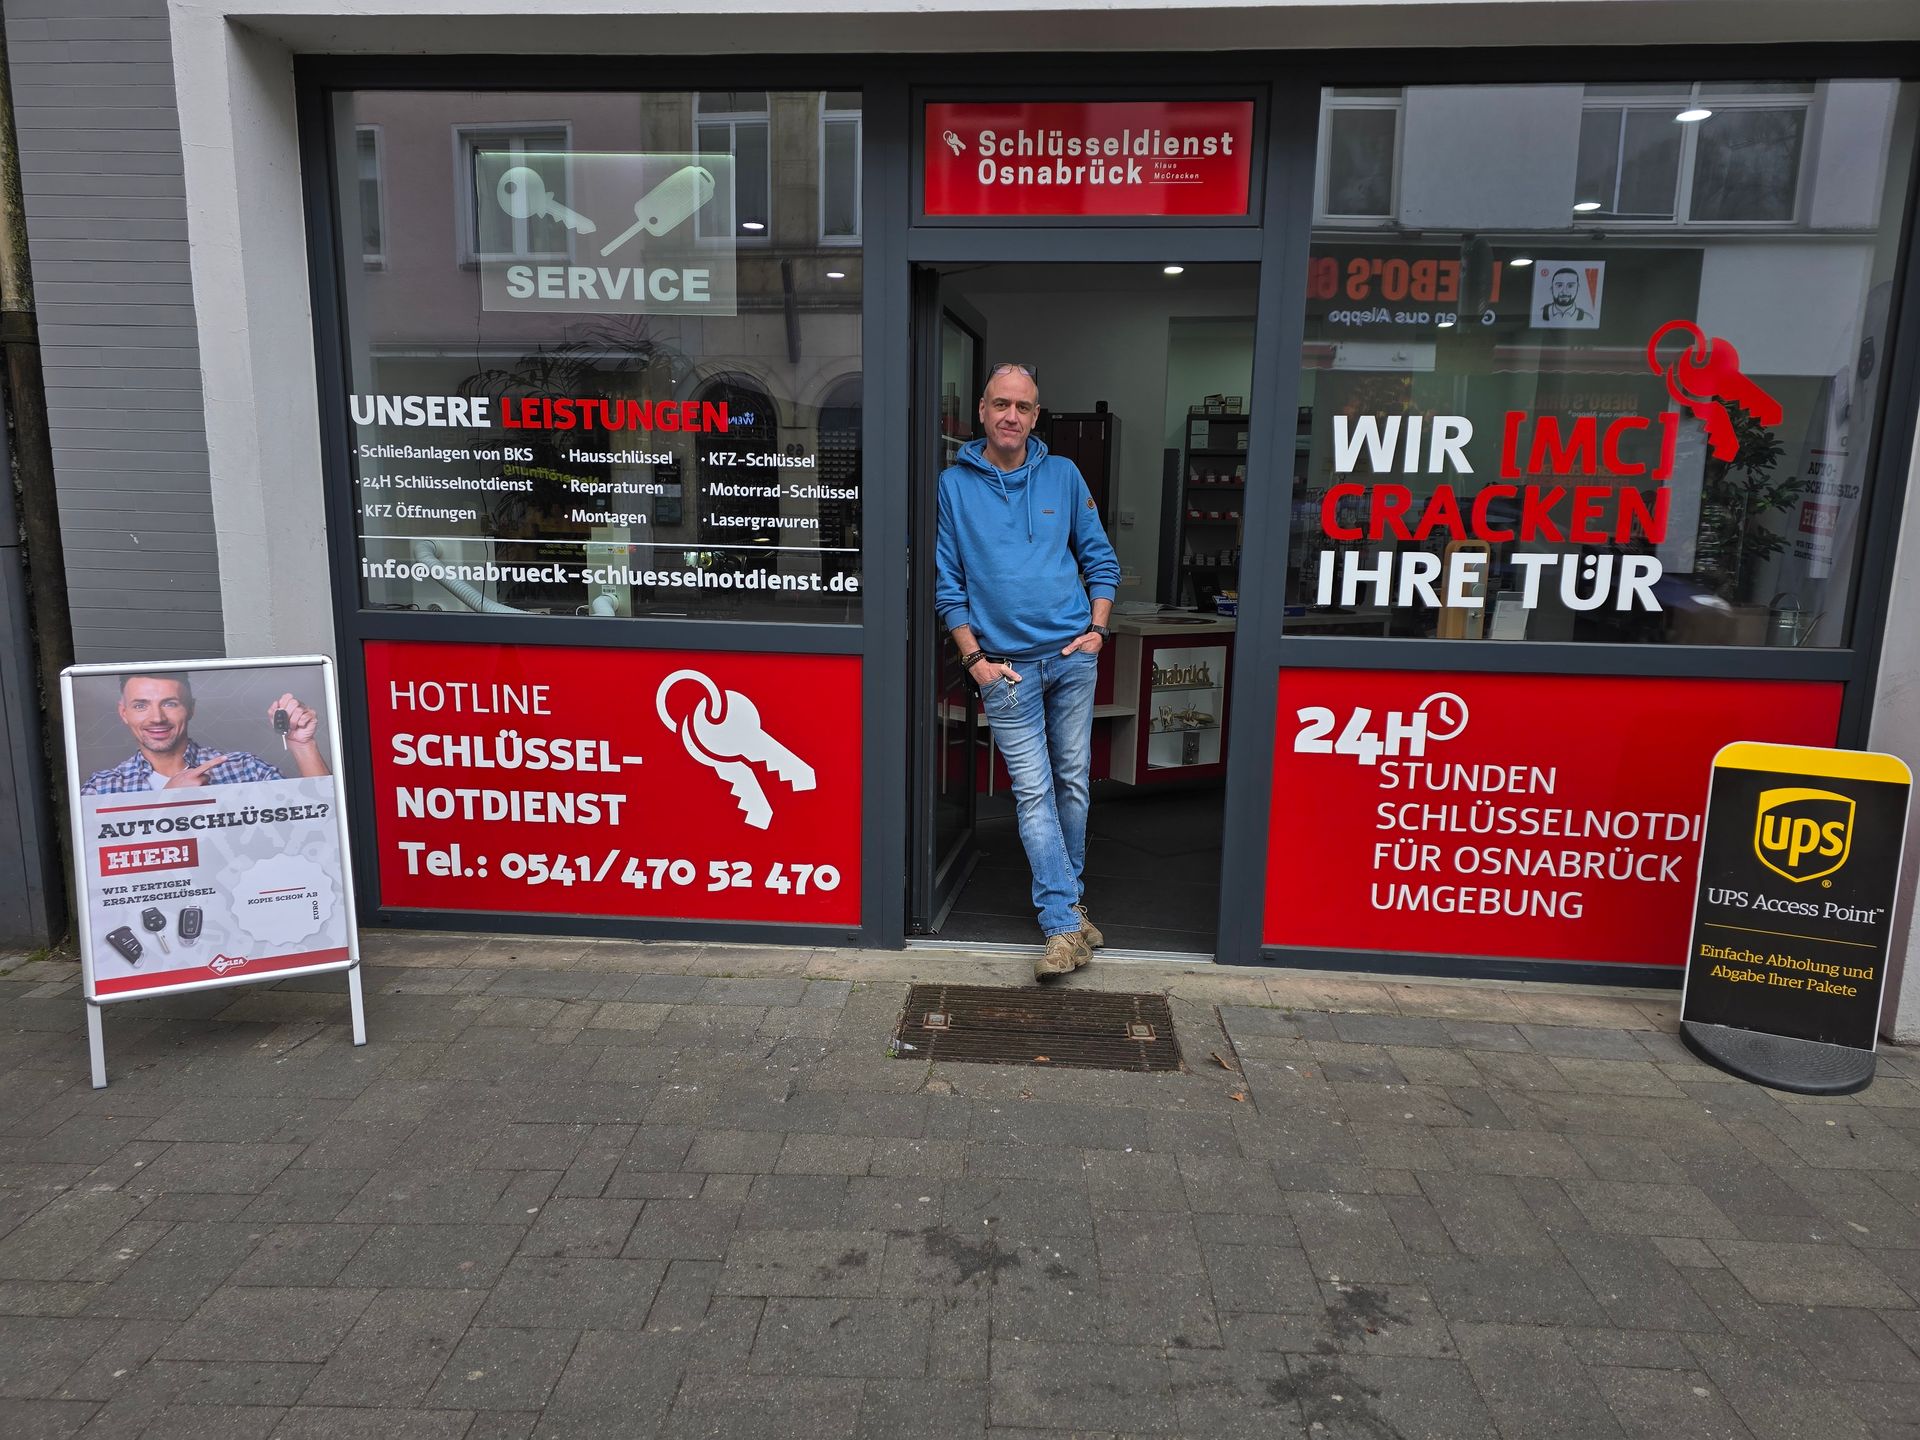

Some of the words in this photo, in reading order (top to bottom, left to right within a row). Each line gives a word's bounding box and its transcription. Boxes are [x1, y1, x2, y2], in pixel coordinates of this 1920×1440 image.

[978, 129, 1233, 157] Schlüsseldienst
[978, 158, 1143, 185] Osnabrück
[1154, 161, 1177, 169] Klaus
[1154, 172, 1200, 180] McCracken
[505, 265, 711, 302] SERVICE
[349, 394, 491, 428] UNSERE
[501, 397, 729, 433] LEISTUNGEN
[360, 444, 470, 463] Schließanlagen
[473, 449, 501, 461] von
[504, 447, 534, 461] BKS
[569, 448, 673, 465] Hausschlüssel
[709, 452, 815, 468] KFZ-Schlüssel
[1333, 415, 1474, 474] WIR
[1501, 411, 1680, 481] [MC]
[362, 474, 392, 490] 24H
[394, 474, 533, 492] Schlüsselnotdienst
[570, 479, 664, 496] Reparaturen
[709, 483, 859, 500] Motorrad-Schlüssel
[365, 504, 393, 518] KFZ
[395, 501, 477, 523] Öffnungen
[571, 509, 647, 527] Montagen
[710, 513, 819, 531] Lasergravuren
[1320, 483, 1671, 544] CRACKEN
[361, 557, 859, 593] info@osnabrueck-schluesselnotdienst.de
[1316, 550, 1488, 608] IHRE
[1511, 553, 1663, 612] TÜR
[390, 681, 551, 715] HOTLINE
[391, 729, 643, 773] SCHLÜSSEL-
[1294, 706, 1428, 765] 24H
[1379, 761, 1557, 795] STUNDEN
[98, 803, 329, 839] AUTOSCHLÜSSEL?
[396, 786, 627, 825] NOTDIENST
[1376, 800, 1701, 842] SCHLÜSSELNOTDI
[107, 844, 190, 870] HIER!
[1763, 815, 1846, 868] ups
[398, 841, 488, 878] Tel.:
[501, 849, 696, 890] 0541/470
[707, 860, 753, 892] 52
[764, 863, 841, 895] 470
[1374, 837, 1441, 872] FÜR
[1454, 845, 1682, 883] OSNABRÜCK
[102, 886, 129, 896] WIR
[131, 879, 192, 893] FERTIGEN
[102, 887, 217, 907] ERSATZSCHLÜSSEL
[247, 897, 274, 905] KOPIE
[275, 892, 303, 901] SCHON
[1371, 883, 1584, 919] UMGEBUNG
[1708, 887, 1749, 908] UPS
[1751, 892, 1819, 917] Access
[311, 900, 320, 920] EURO
[1700, 944, 1764, 965] Einfache
[1766, 953, 1840, 977] Abholung
[1843, 965, 1875, 982] und
[1710, 964, 1766, 986] Abgabe
[1767, 974, 1805, 991] Ihrer
[1805, 980, 1858, 999] Pakete
